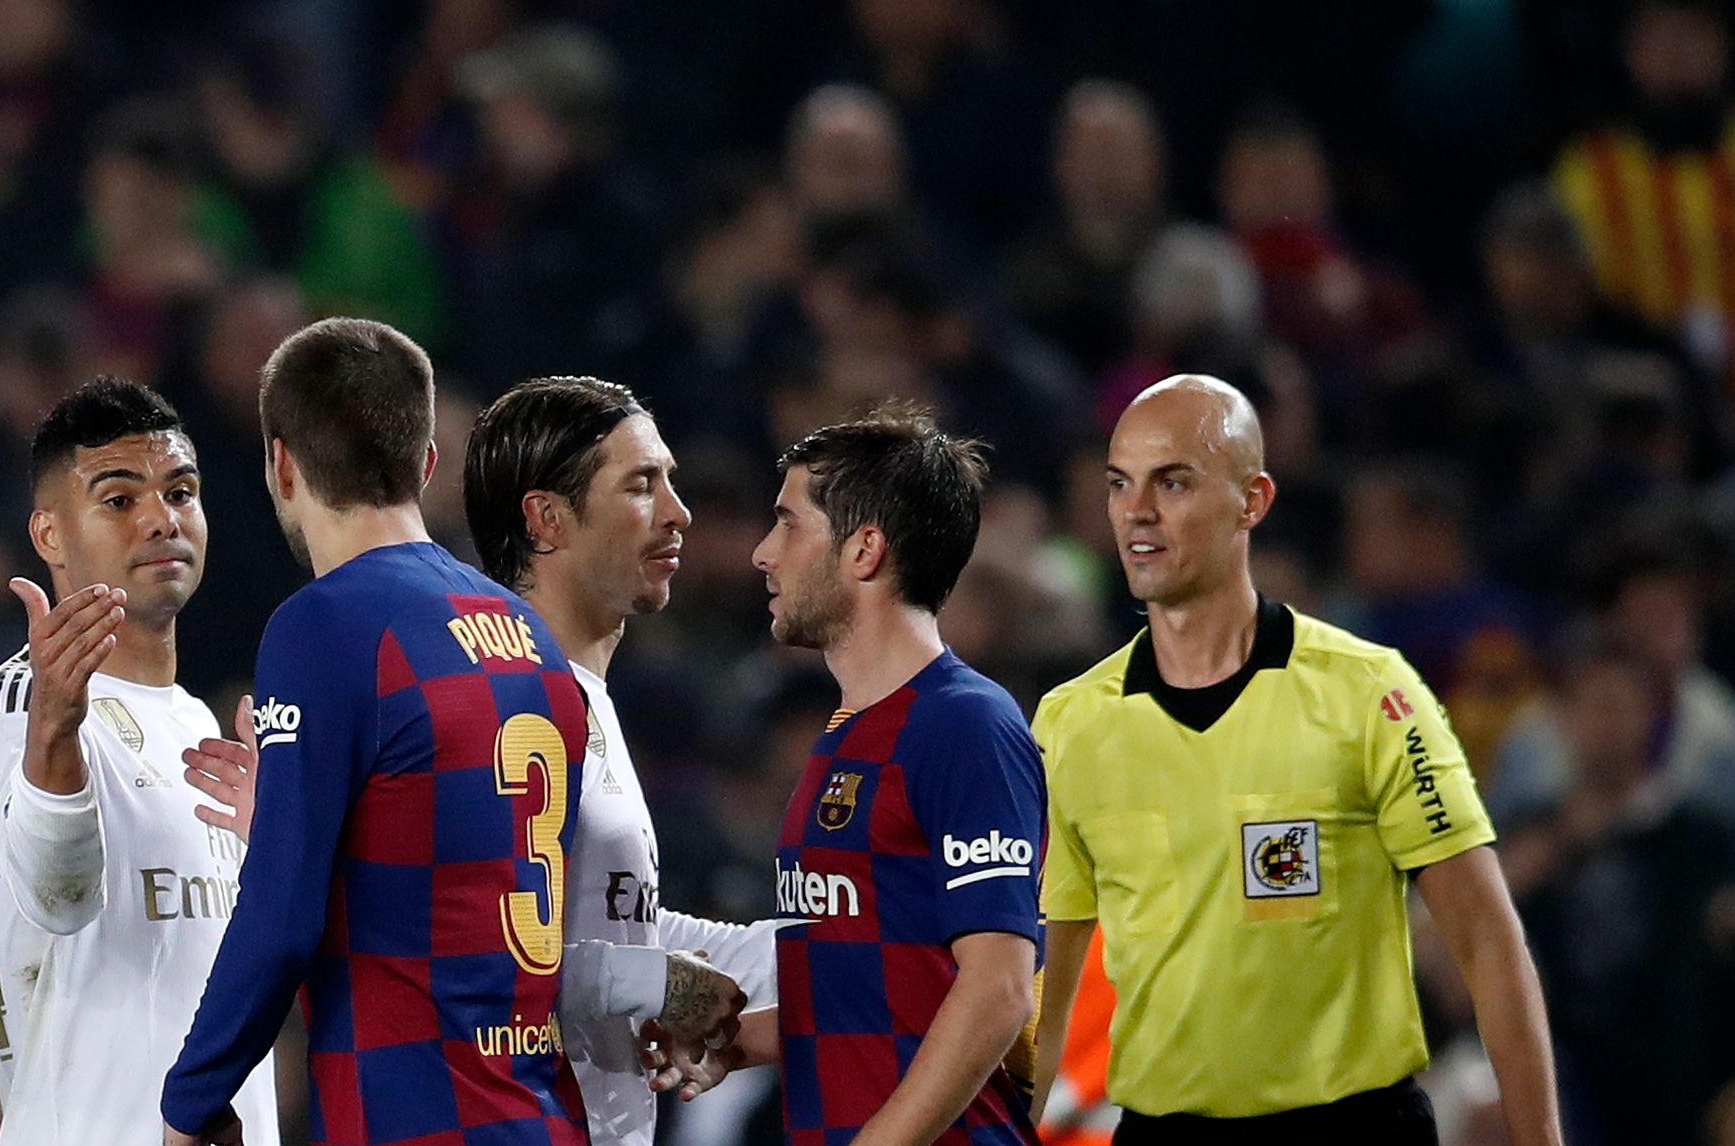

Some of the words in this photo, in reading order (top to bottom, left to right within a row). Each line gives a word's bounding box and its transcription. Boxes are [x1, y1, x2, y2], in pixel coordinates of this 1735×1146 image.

[447, 611, 544, 666] PIQUÉ
[1405, 726, 1453, 835] WÜRTH
[494, 713, 568, 977] 3
[942, 829, 1034, 868] beko
